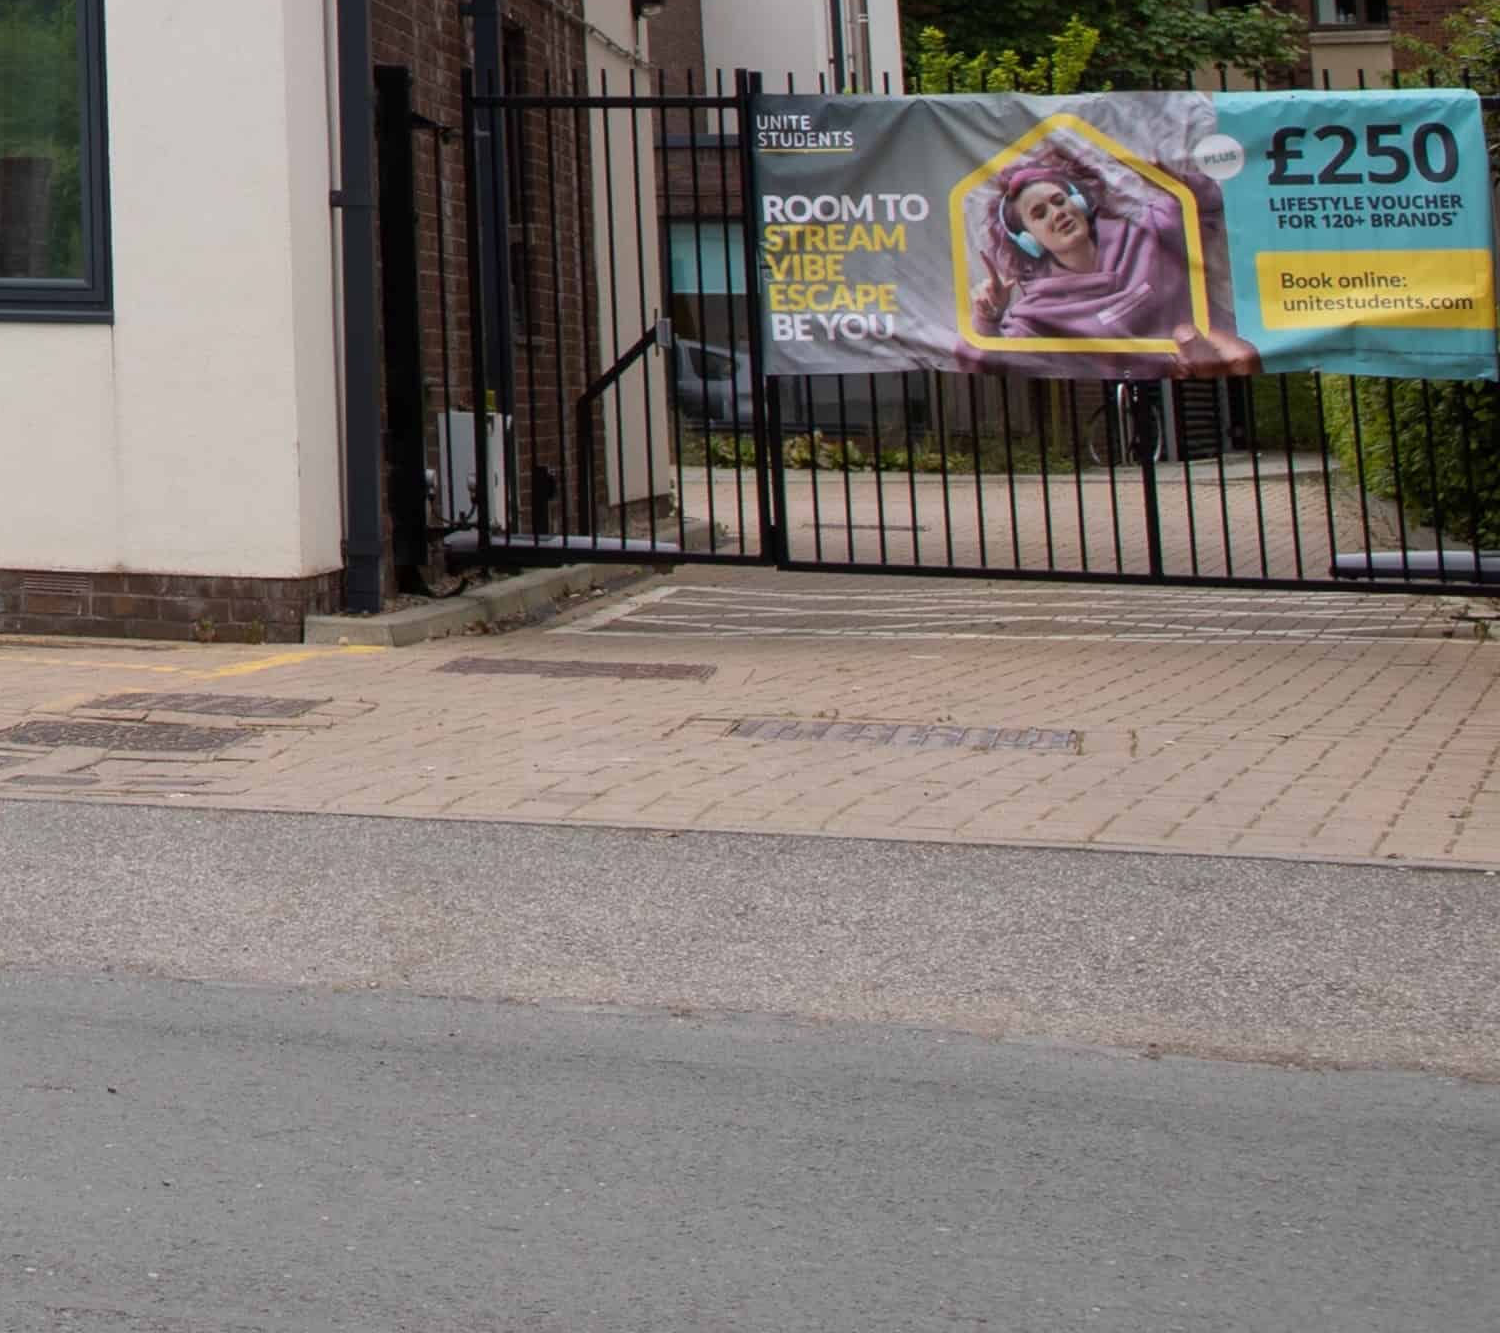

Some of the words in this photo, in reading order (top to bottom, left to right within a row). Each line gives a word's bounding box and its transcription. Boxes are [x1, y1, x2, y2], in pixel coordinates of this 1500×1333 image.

[756, 114, 812, 131] UNITE
[757, 131, 854, 148] STUDENTS
[1203, 150, 1237, 166] PLUS
[1265, 122, 1459, 186] £250
[762, 194, 874, 223] ROOM
[878, 193, 929, 222] TO
[1269, 196, 1364, 212] LIFESTYLE
[1368, 194, 1464, 210] VOUCHER
[1277, 213, 1317, 229] FOR
[1323, 212, 1365, 228] 120+
[764, 223, 908, 253] STREAM
[765, 254, 845, 282] VIBE
[1280, 272, 1333, 290] Book
[1339, 271, 1407, 289] online:
[768, 284, 898, 312] ESCAPE
[1283, 294, 1473, 311] unitestudents.com
[771, 313, 814, 341] BE
[816, 313, 895, 340] YOU
